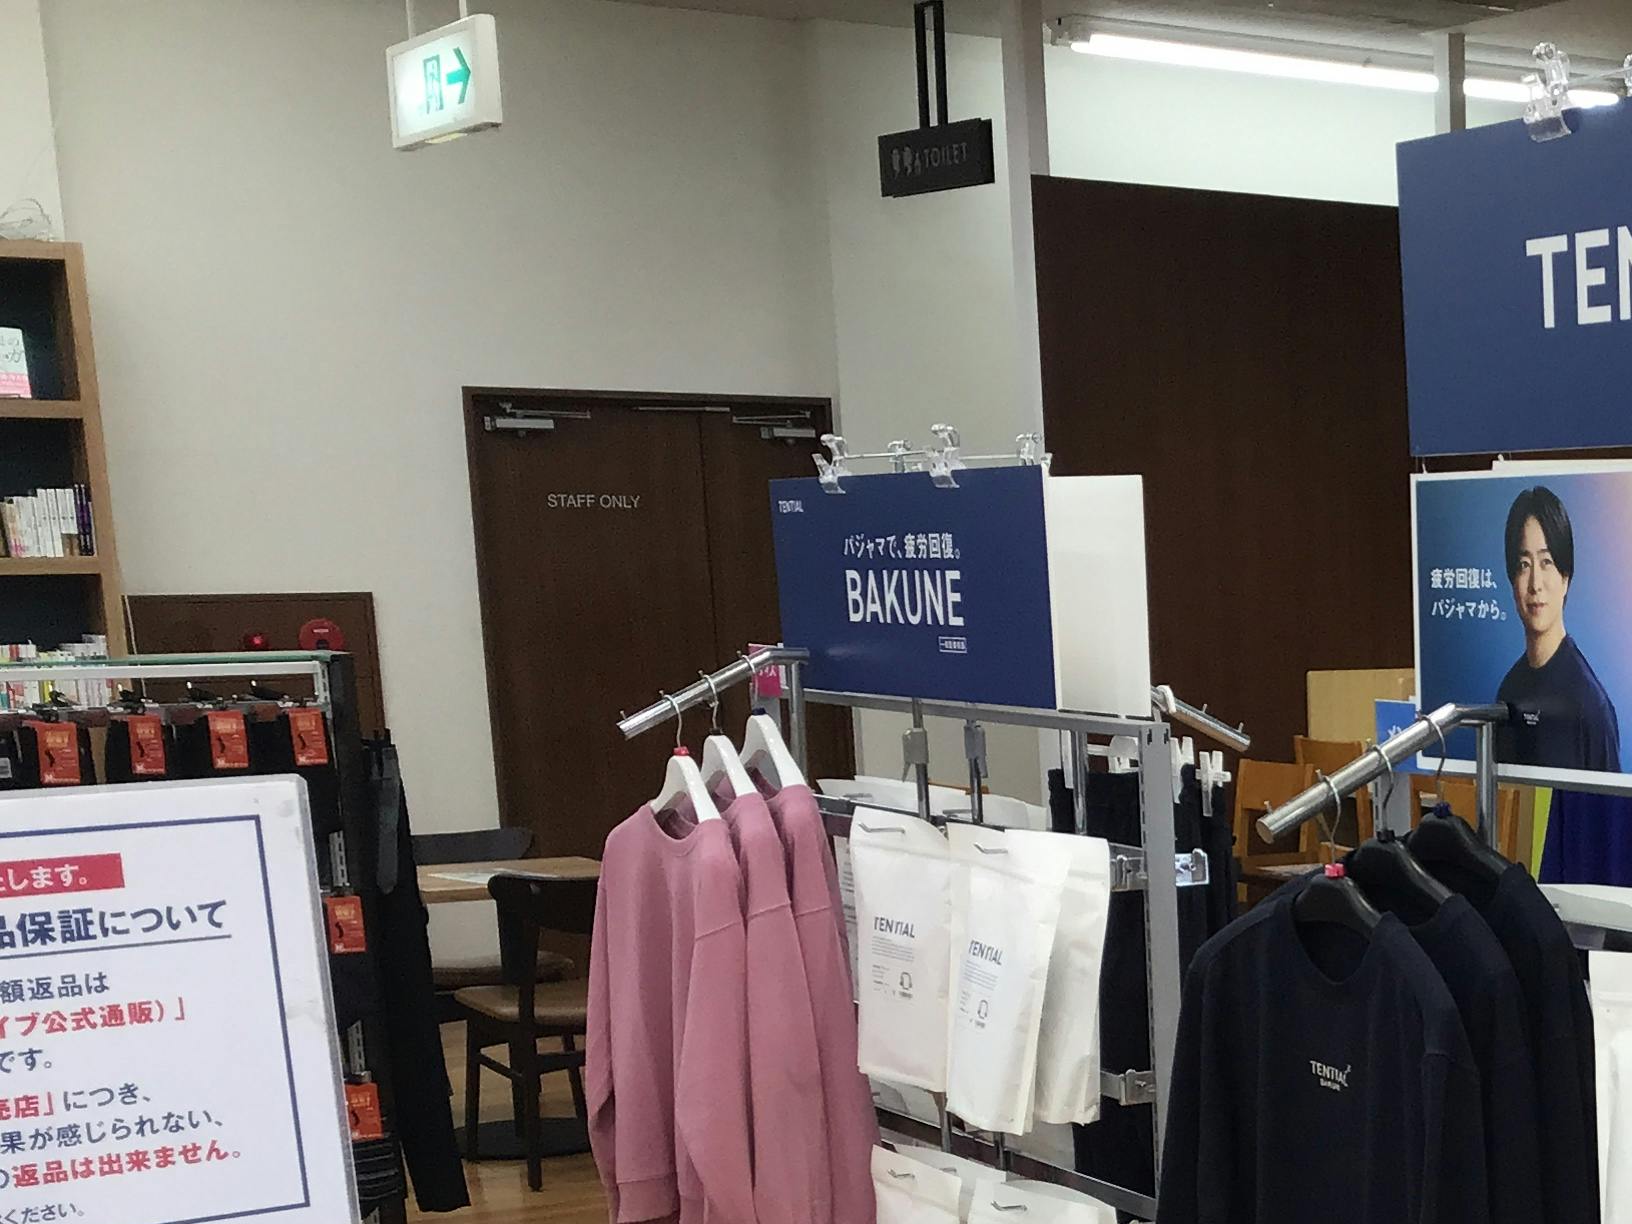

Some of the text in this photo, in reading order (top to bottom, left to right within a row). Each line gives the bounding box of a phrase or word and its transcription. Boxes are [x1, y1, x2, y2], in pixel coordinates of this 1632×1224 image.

[924, 142, 967, 169] TOILET
[547, 493, 640, 508] STAFF ONLY
[843, 533, 961, 559] パジャマで、疲労回復。
[1430, 567, 1497, 589] 疲労回復は、
[845, 569, 965, 626] BAKUNE
[1431, 598, 1507, 621] パジャマから。
[873, 916, 916, 939] TENTIAL
[968, 939, 1003, 966] TENTIAL
[0, 1048, 54, 1074] です。
[0, 1111, 225, 1156] 果が感じられない、
